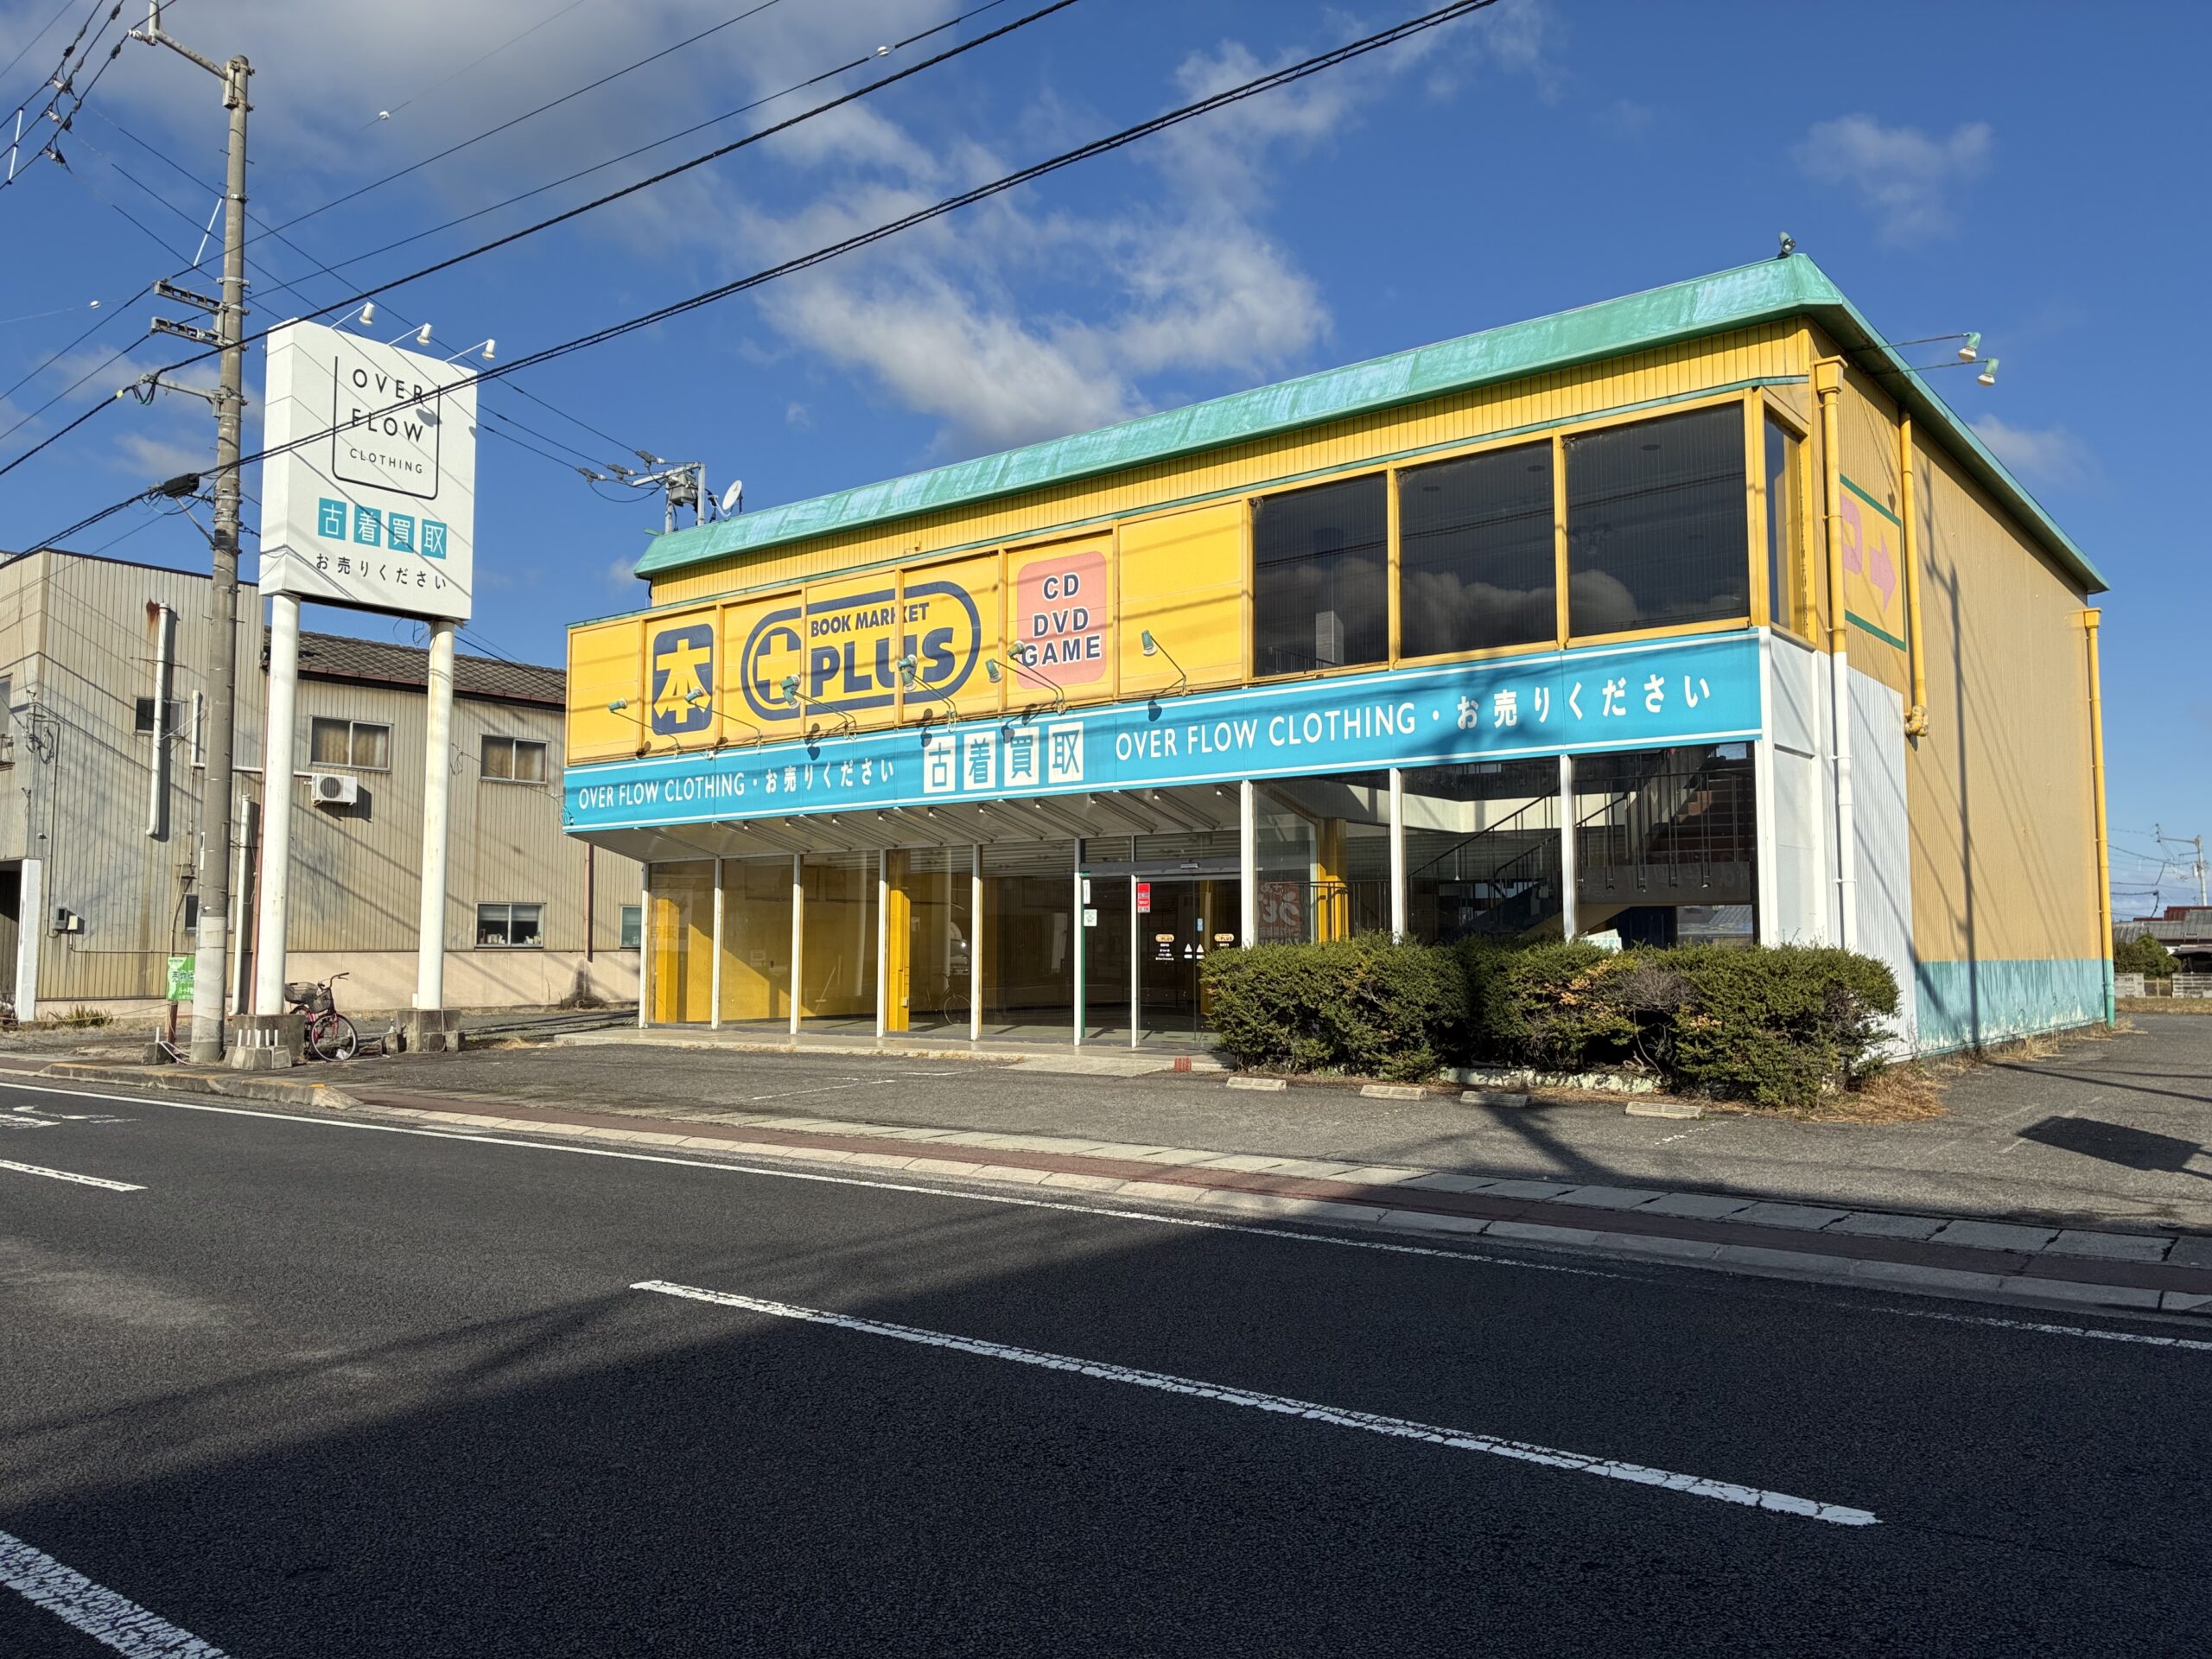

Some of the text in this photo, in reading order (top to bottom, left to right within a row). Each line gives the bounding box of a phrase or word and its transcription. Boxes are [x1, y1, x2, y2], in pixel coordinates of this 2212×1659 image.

[353, 368, 423, 404] OVER
[352, 408, 423, 442] FLOW
[349, 448, 423, 474] CLOTHING
[321, 504, 444, 555] 古着買取
[316, 553, 447, 589] お売りください
[1043, 573, 1079, 600] CD
[810, 614, 851, 638] BOOK
[1033, 607, 1089, 637] DVD
[810, 627, 956, 698] PLUS
[1021, 635, 1100, 667] GAME
[653, 638, 712, 724] 本
[1116, 728, 1178, 761] OVER
[1187, 719, 1258, 754] FLOW
[1268, 702, 1415, 747] CLOTHING
[1457, 673, 1711, 730] お売りください
[928, 730, 1080, 787] 古着買取
[579, 786, 614, 810] OVER
[619, 781, 659, 806] FLOW
[664, 772, 745, 802] CLOTHING
[765, 758, 894, 793] お売りください
